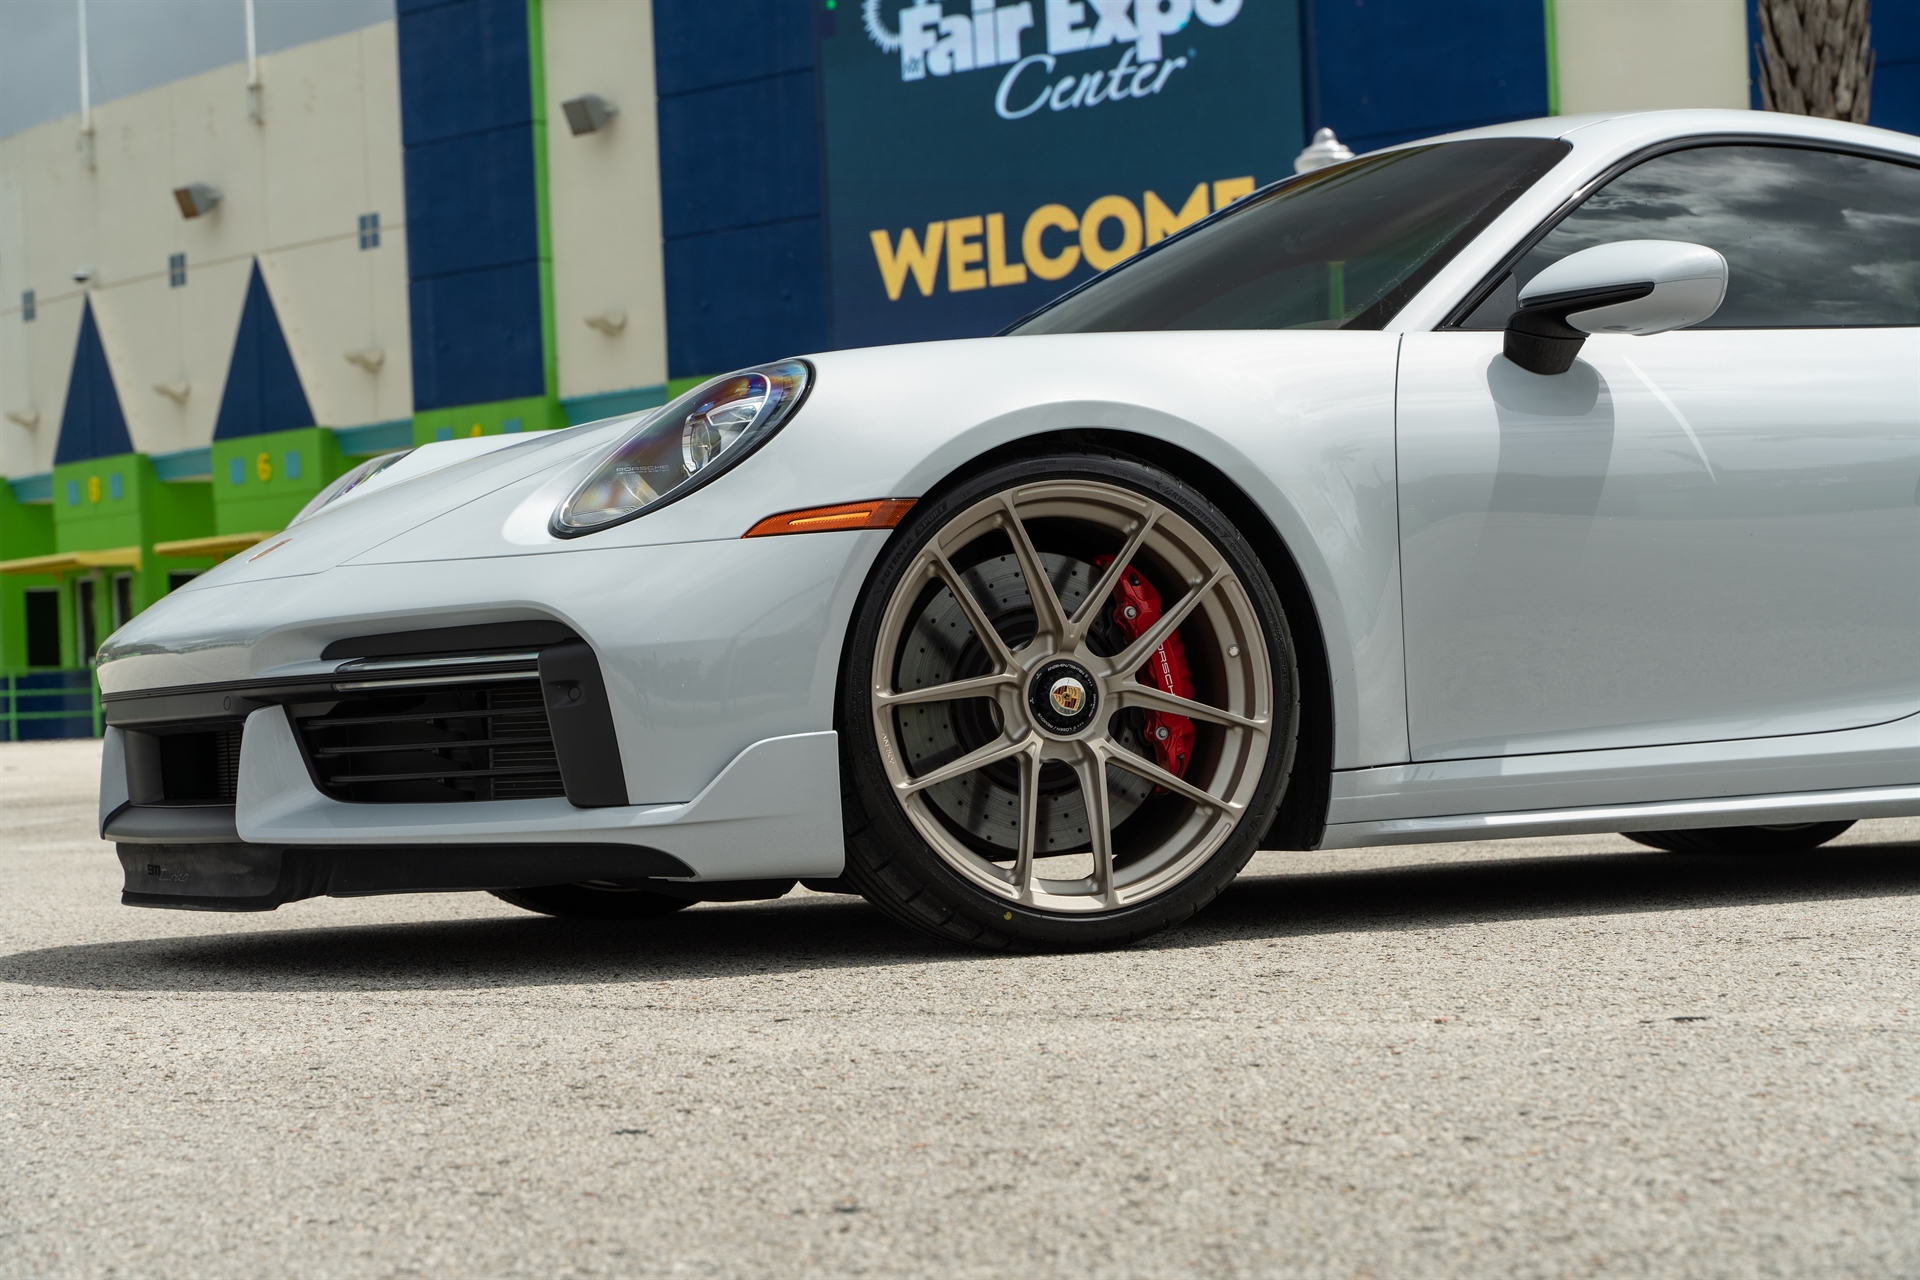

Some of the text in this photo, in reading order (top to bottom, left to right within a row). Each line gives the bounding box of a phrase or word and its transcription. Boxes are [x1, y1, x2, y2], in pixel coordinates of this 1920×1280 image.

[898, 0, 1034, 82] Fair
[996, 46, 1188, 119] Center
[256, 452, 272, 482] 6
[615, 464, 670, 472] PORSCHE
[917, 504, 945, 533] SPORT
[1164, 487, 1221, 534] BRIDGESTONE
[880, 537, 914, 586] POTENZA
[1157, 643, 1176, 696] ORSCH
[147, 864, 189, 883] 911 turbo
